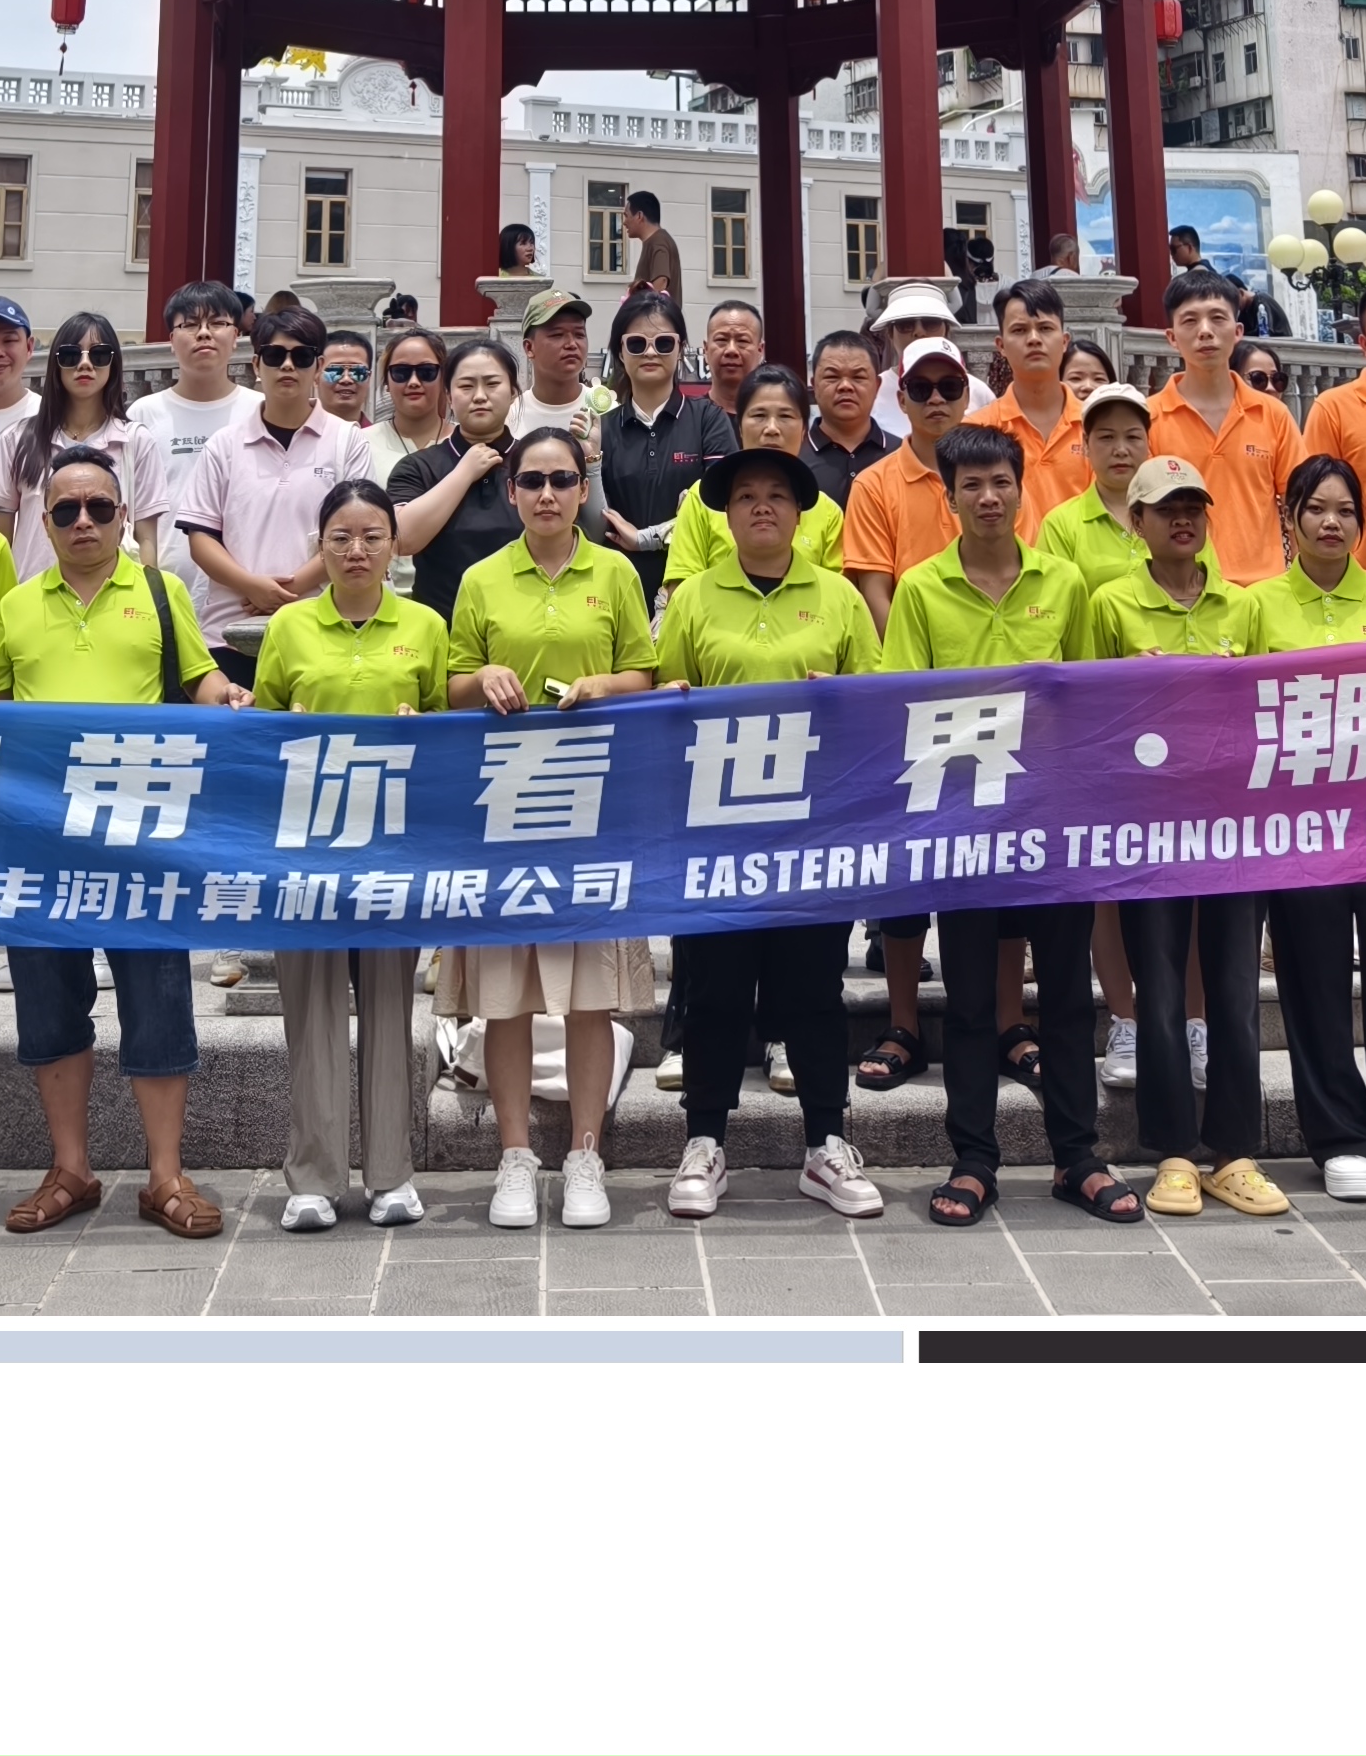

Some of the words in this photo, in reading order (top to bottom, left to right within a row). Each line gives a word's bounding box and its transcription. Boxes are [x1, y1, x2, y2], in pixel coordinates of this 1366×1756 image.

[683, 841, 890, 900] EASTERN
[904, 828, 1047, 883] TIMES
[1062, 807, 1352, 868] TECHNOLOGY
